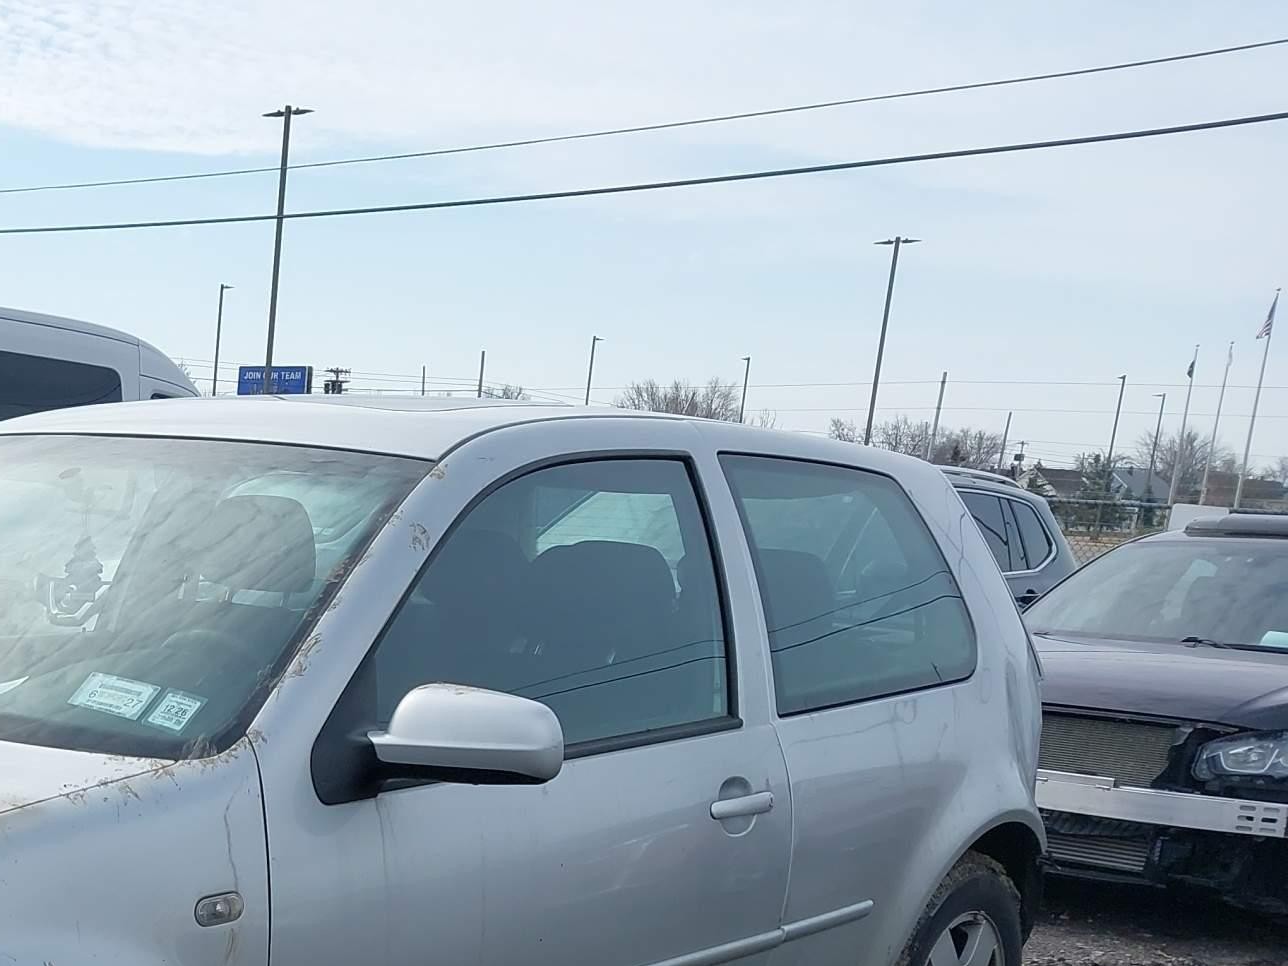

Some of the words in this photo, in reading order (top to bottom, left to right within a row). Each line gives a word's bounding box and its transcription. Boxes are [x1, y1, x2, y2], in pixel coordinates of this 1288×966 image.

[244, 371, 261, 380] JOIN
[280, 371, 301, 380] TEAM
[123, 698, 143, 708] 27
